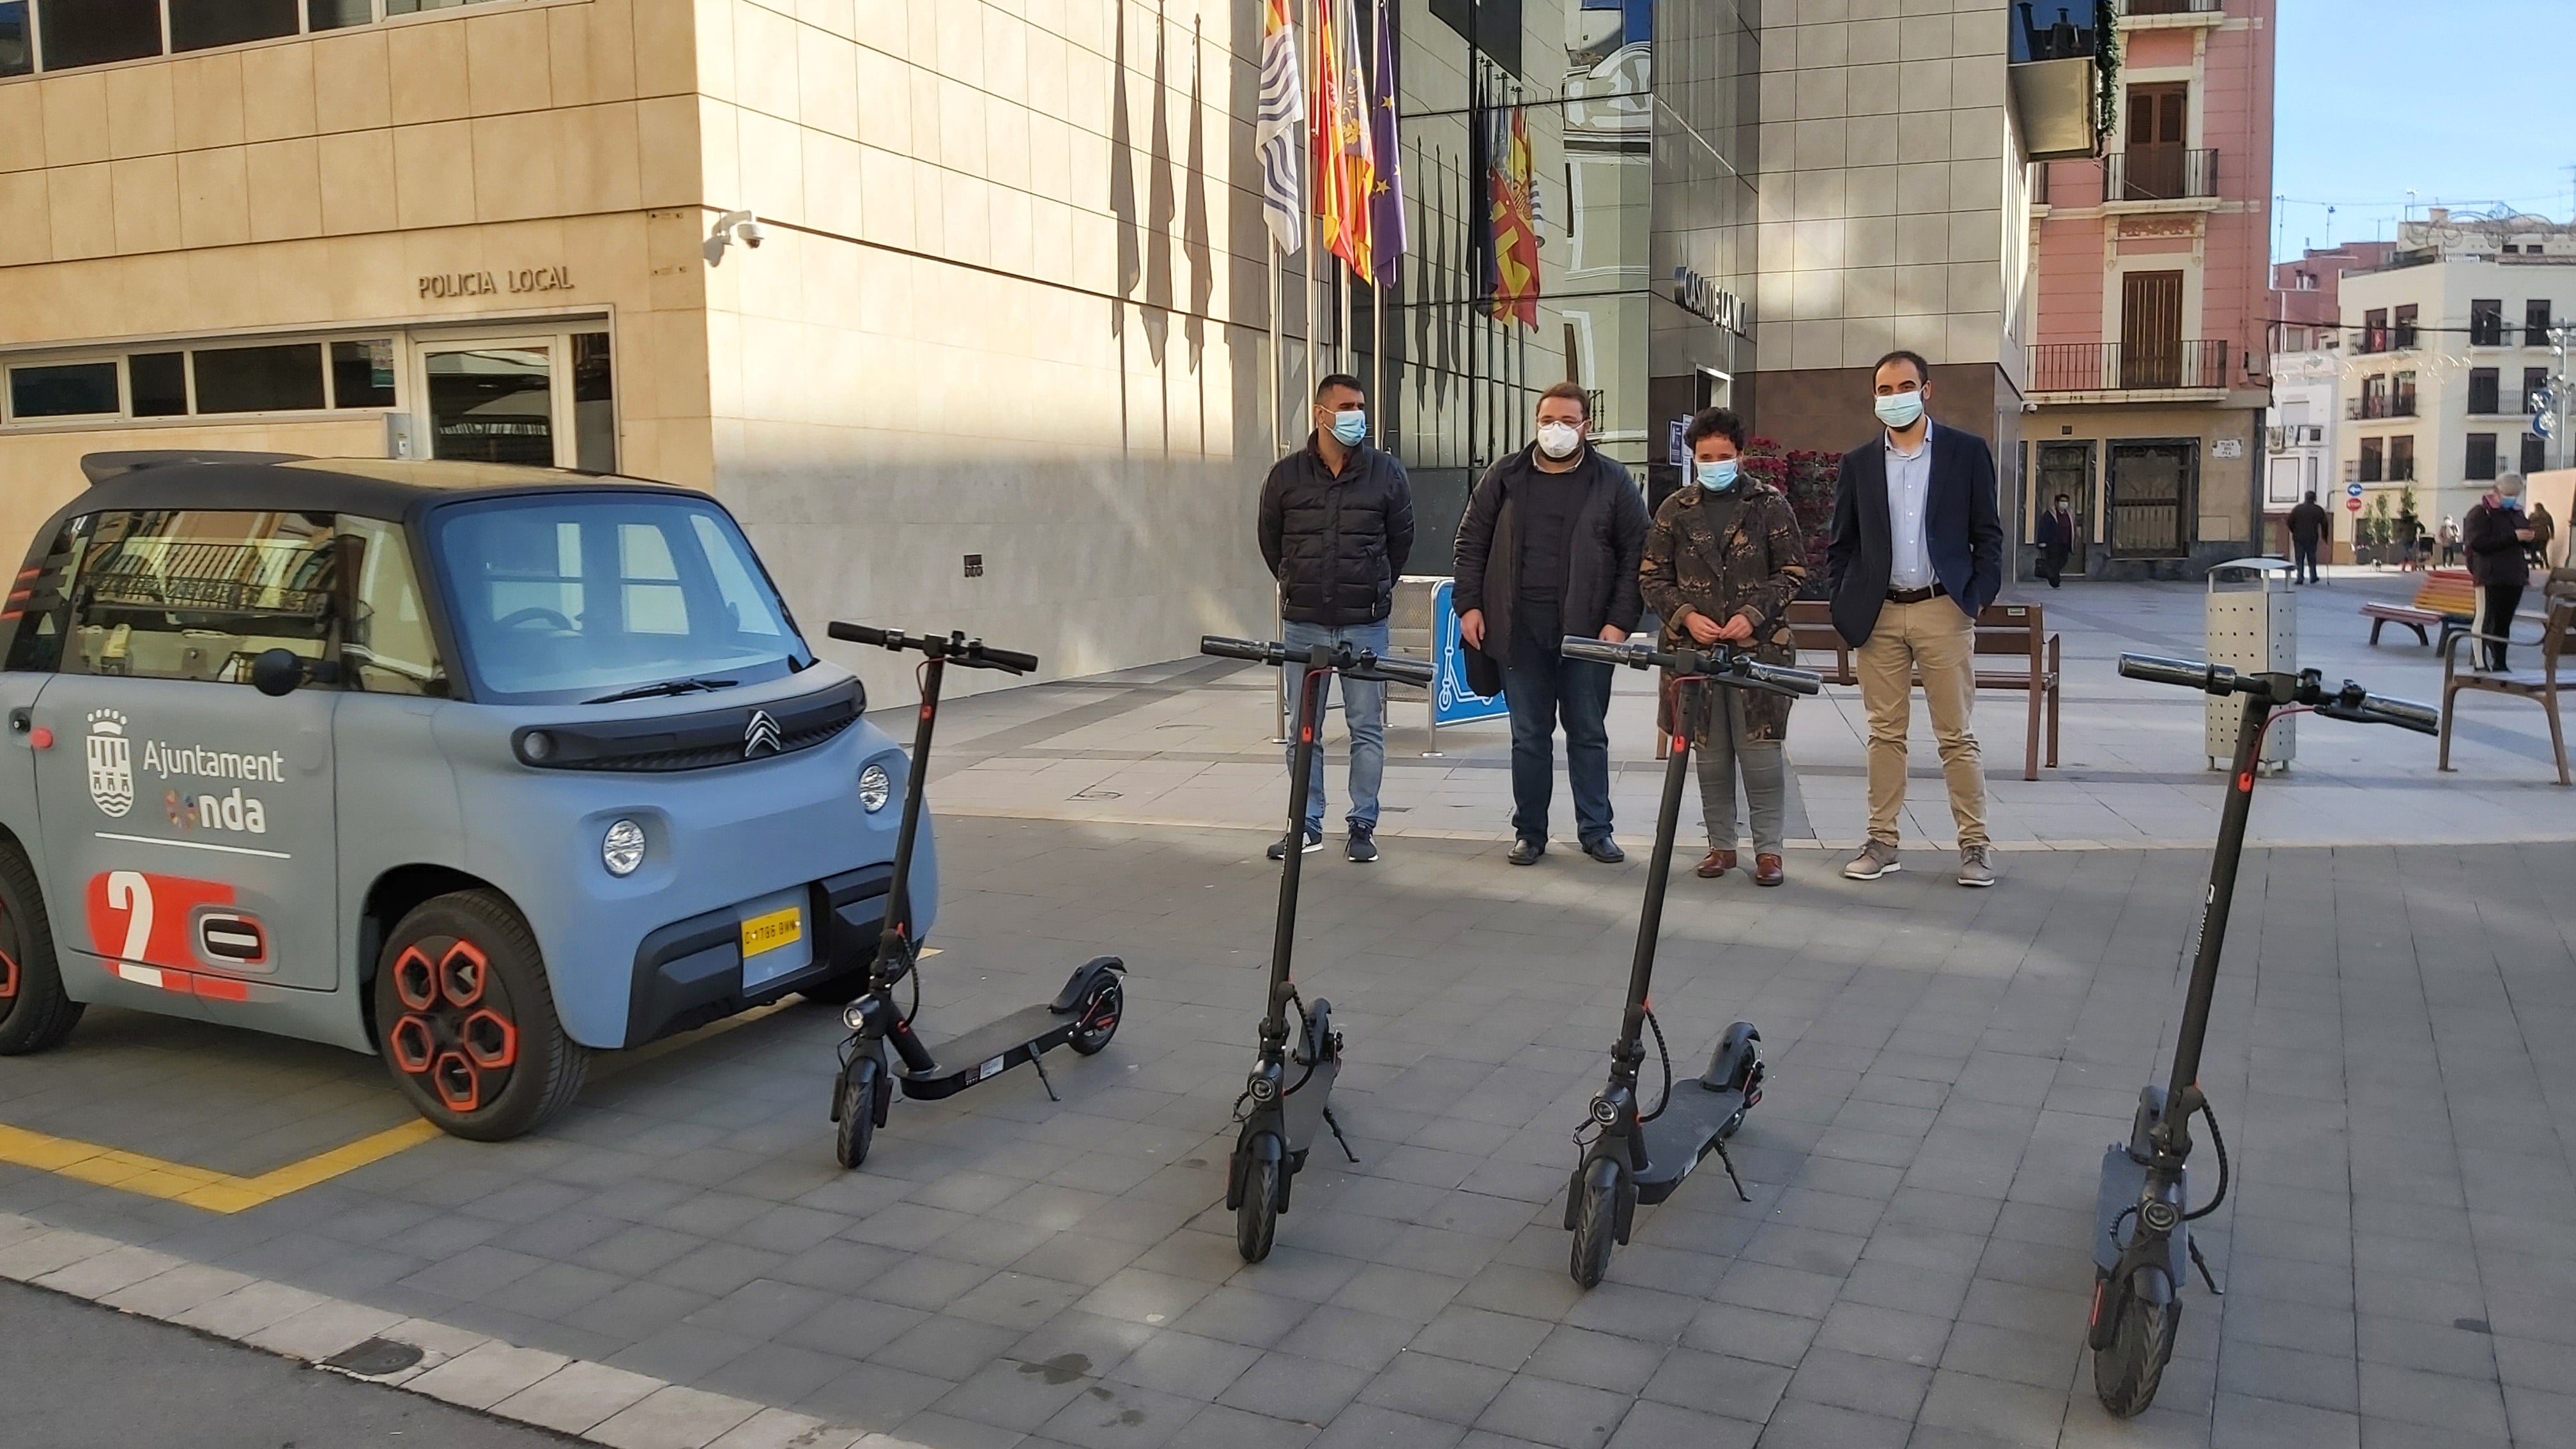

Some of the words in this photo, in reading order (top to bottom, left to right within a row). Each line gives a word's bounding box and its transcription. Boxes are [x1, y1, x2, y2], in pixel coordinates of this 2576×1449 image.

[419, 272, 497, 299] POLICIA
[508, 266, 576, 293] LOCAL
[1675, 266, 1706, 318] CASA
[142, 739, 286, 783] Ajuntament
[107, 870, 164, 988] 2
